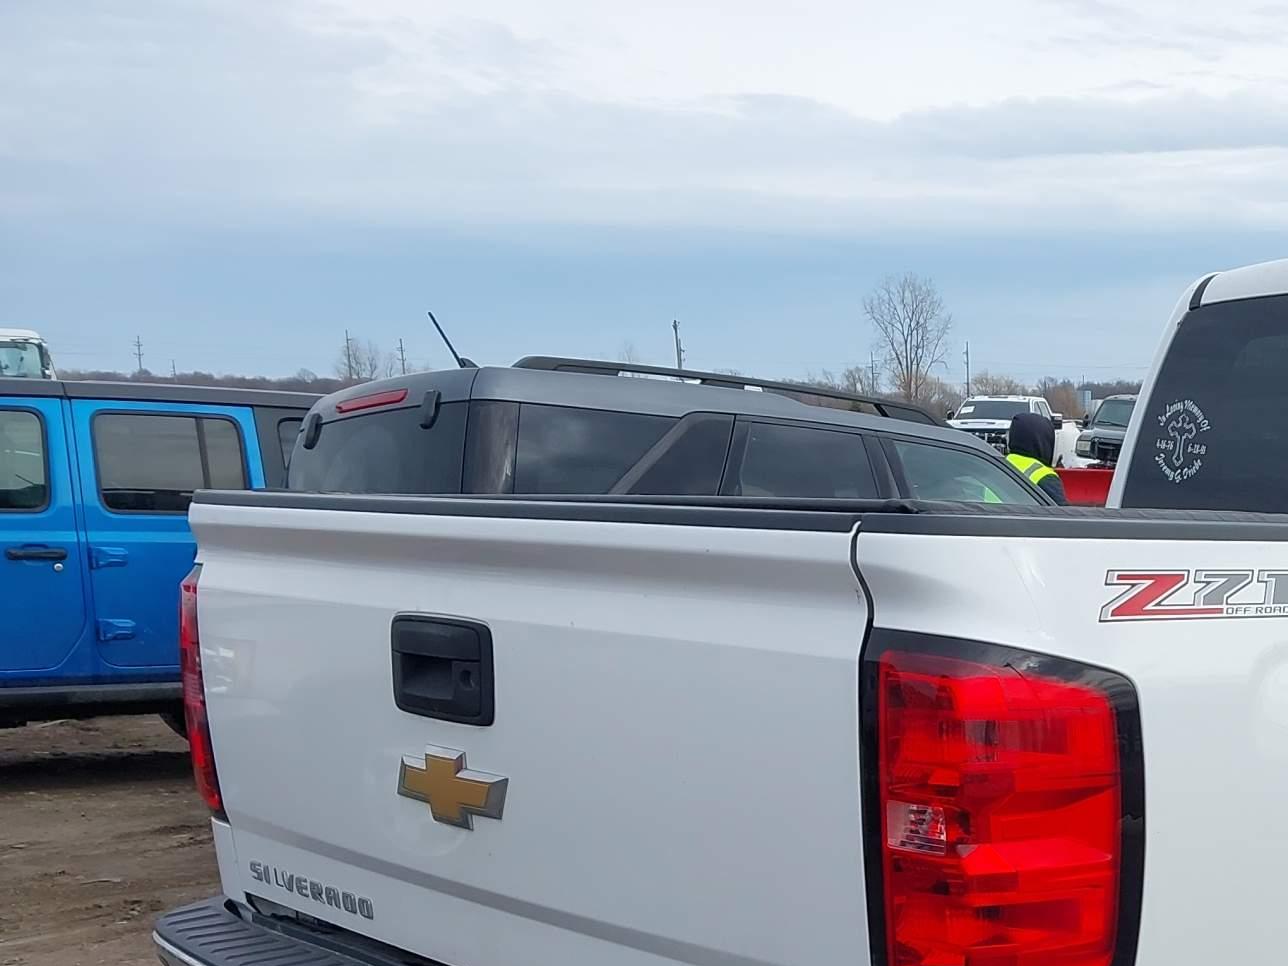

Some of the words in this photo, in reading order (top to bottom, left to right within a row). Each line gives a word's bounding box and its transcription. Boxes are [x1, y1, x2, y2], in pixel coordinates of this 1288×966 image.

[1184, 400, 1205, 423] Memory
[1226, 606, 1250, 615] OFF
[249, 861, 375, 921] SILVERADO
